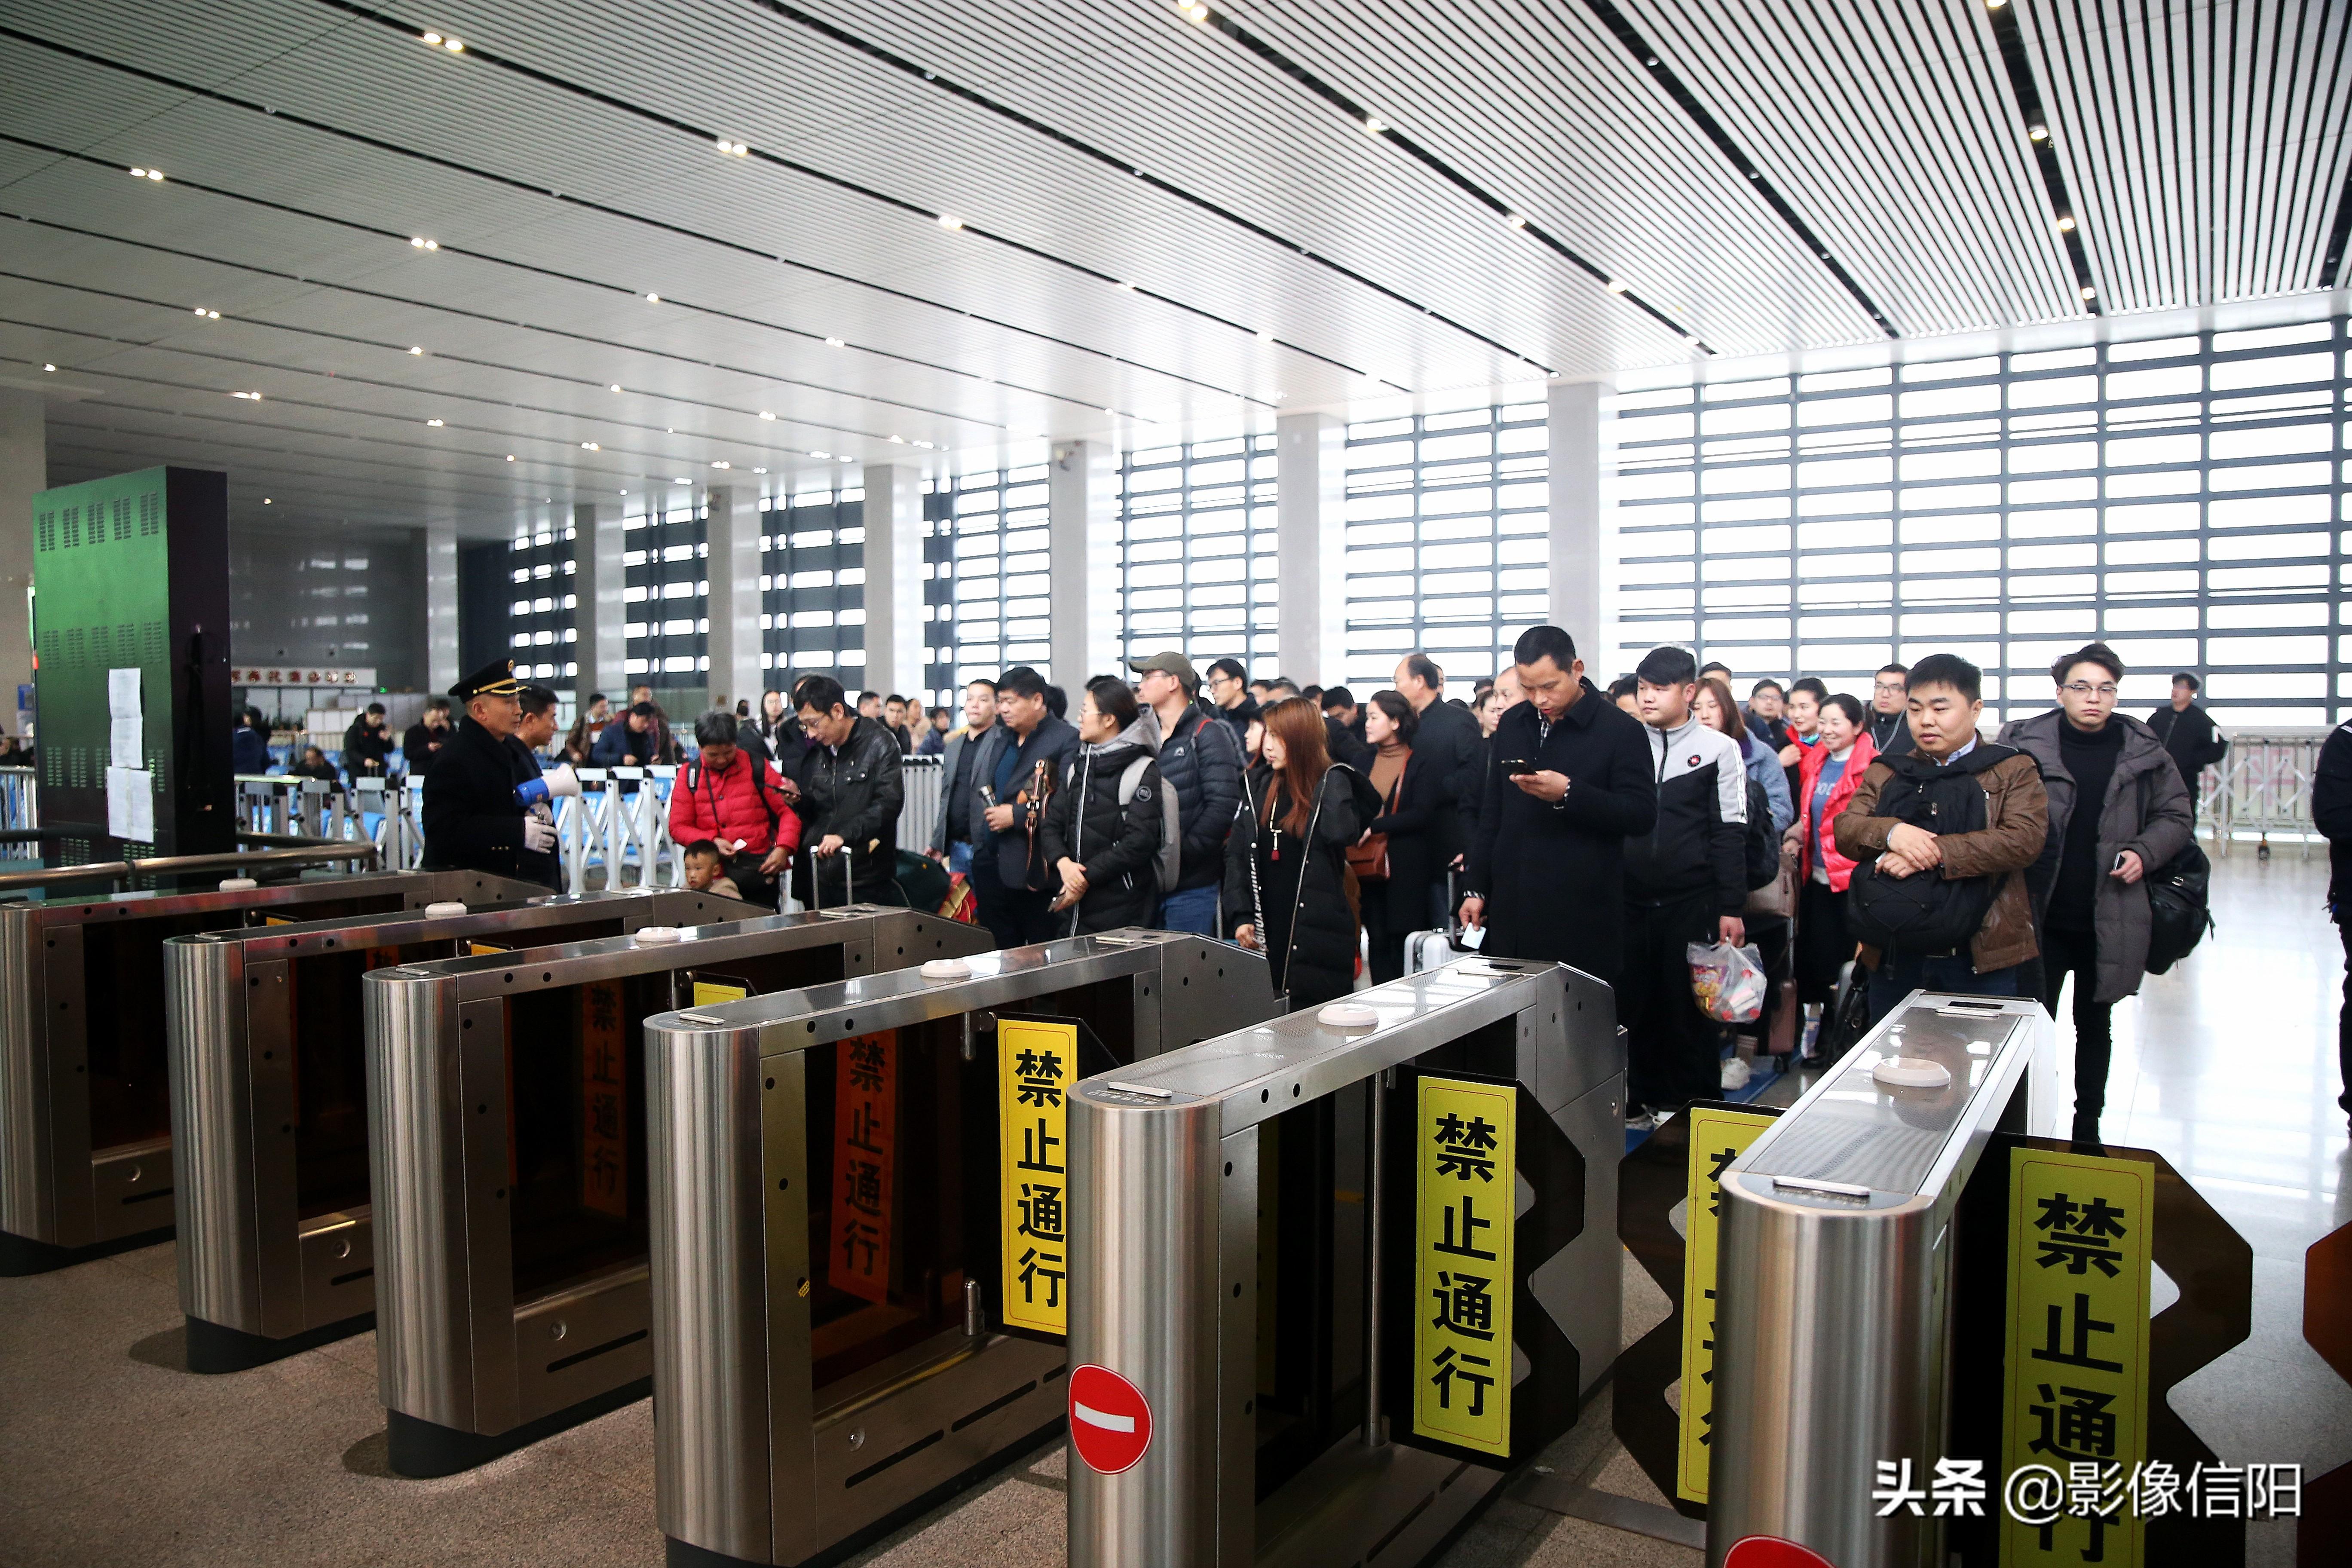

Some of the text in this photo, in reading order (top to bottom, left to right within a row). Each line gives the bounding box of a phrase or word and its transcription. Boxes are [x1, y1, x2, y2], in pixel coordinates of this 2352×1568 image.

[591, 984, 619, 1194] 禁止通行
[842, 1036, 885, 1276] 禁止通行
[1015, 1048, 1065, 1308] 禁止通行
[1431, 1113, 1498, 1416] 禁止通行
